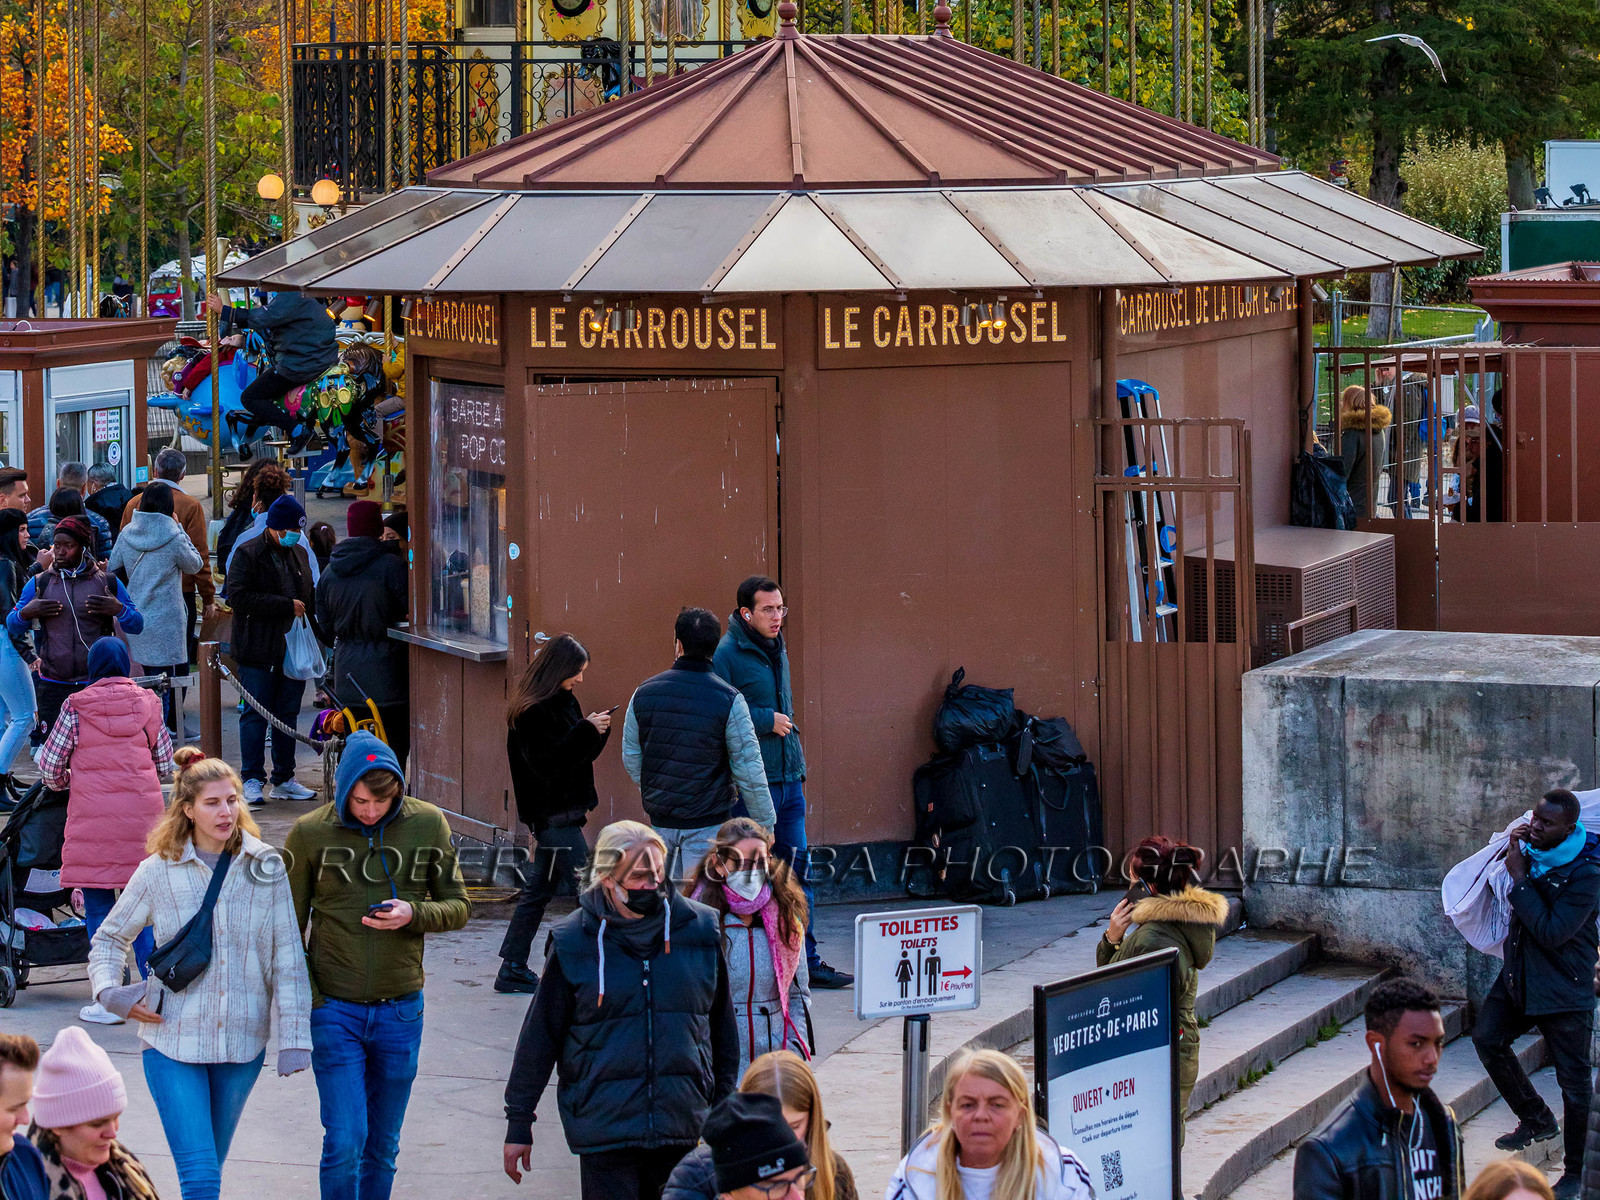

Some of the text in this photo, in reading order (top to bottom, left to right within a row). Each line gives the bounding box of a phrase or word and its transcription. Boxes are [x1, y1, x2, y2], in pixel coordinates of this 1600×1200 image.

[410, 298, 498, 345] LE CARROUSEL
[1120, 287, 1190, 335] CARROUSEL
[1195, 286, 1209, 324] DE
[1214, 285, 1228, 322] LA
[530, 307, 777, 350] LE CARROUSEL
[824, 301, 1067, 349] LE CARROUSEL
[451, 398, 490, 427] BARBE
[461, 434, 486, 460] POP
[879, 915, 959, 937] TOILETTES
[900, 937, 938, 950] TOILETS
[893, 999, 912, 1008] ponton
[912, 994, 956, 1005] d'embarquement
[1053, 1008, 1158, 1056] VEDETTES DE PARIS
[1072, 1077, 1135, 1113] OUVERT OPEN
[1074, 1124, 1093, 1135] Consultez
[1101, 1116, 1118, 1126] horaires
[1118, 1113, 1124, 1121] de
[1100, 1126, 1121, 1138] departure
[1121, 1123, 1133, 1131] times
